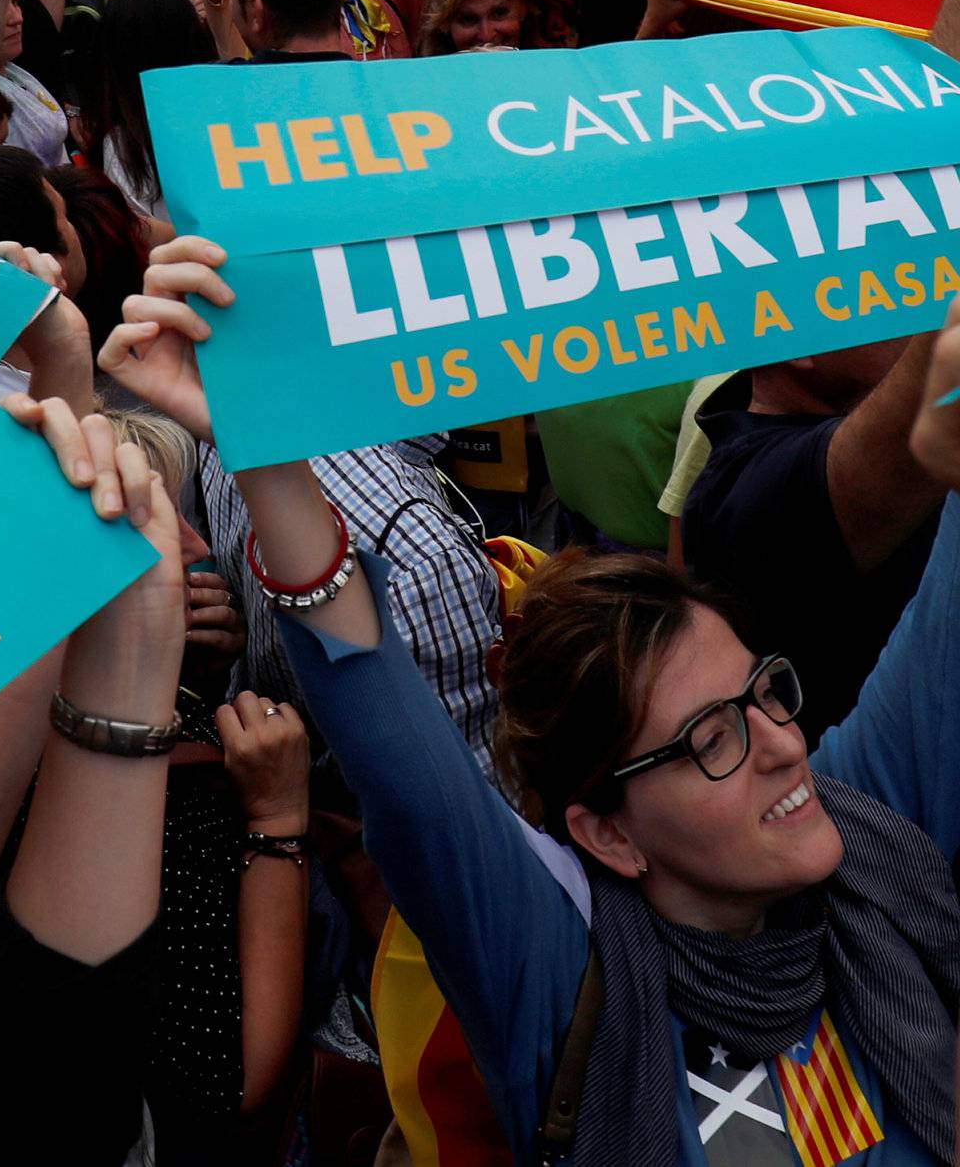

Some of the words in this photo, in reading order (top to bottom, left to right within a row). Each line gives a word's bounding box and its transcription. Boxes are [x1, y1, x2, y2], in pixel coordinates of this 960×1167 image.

[207, 111, 453, 190] HELP
[487, 63, 960, 157] CATALONIA
[390, 348, 478, 407] US
[501, 301, 726, 384] VOLEM
[753, 290, 794, 337] A
